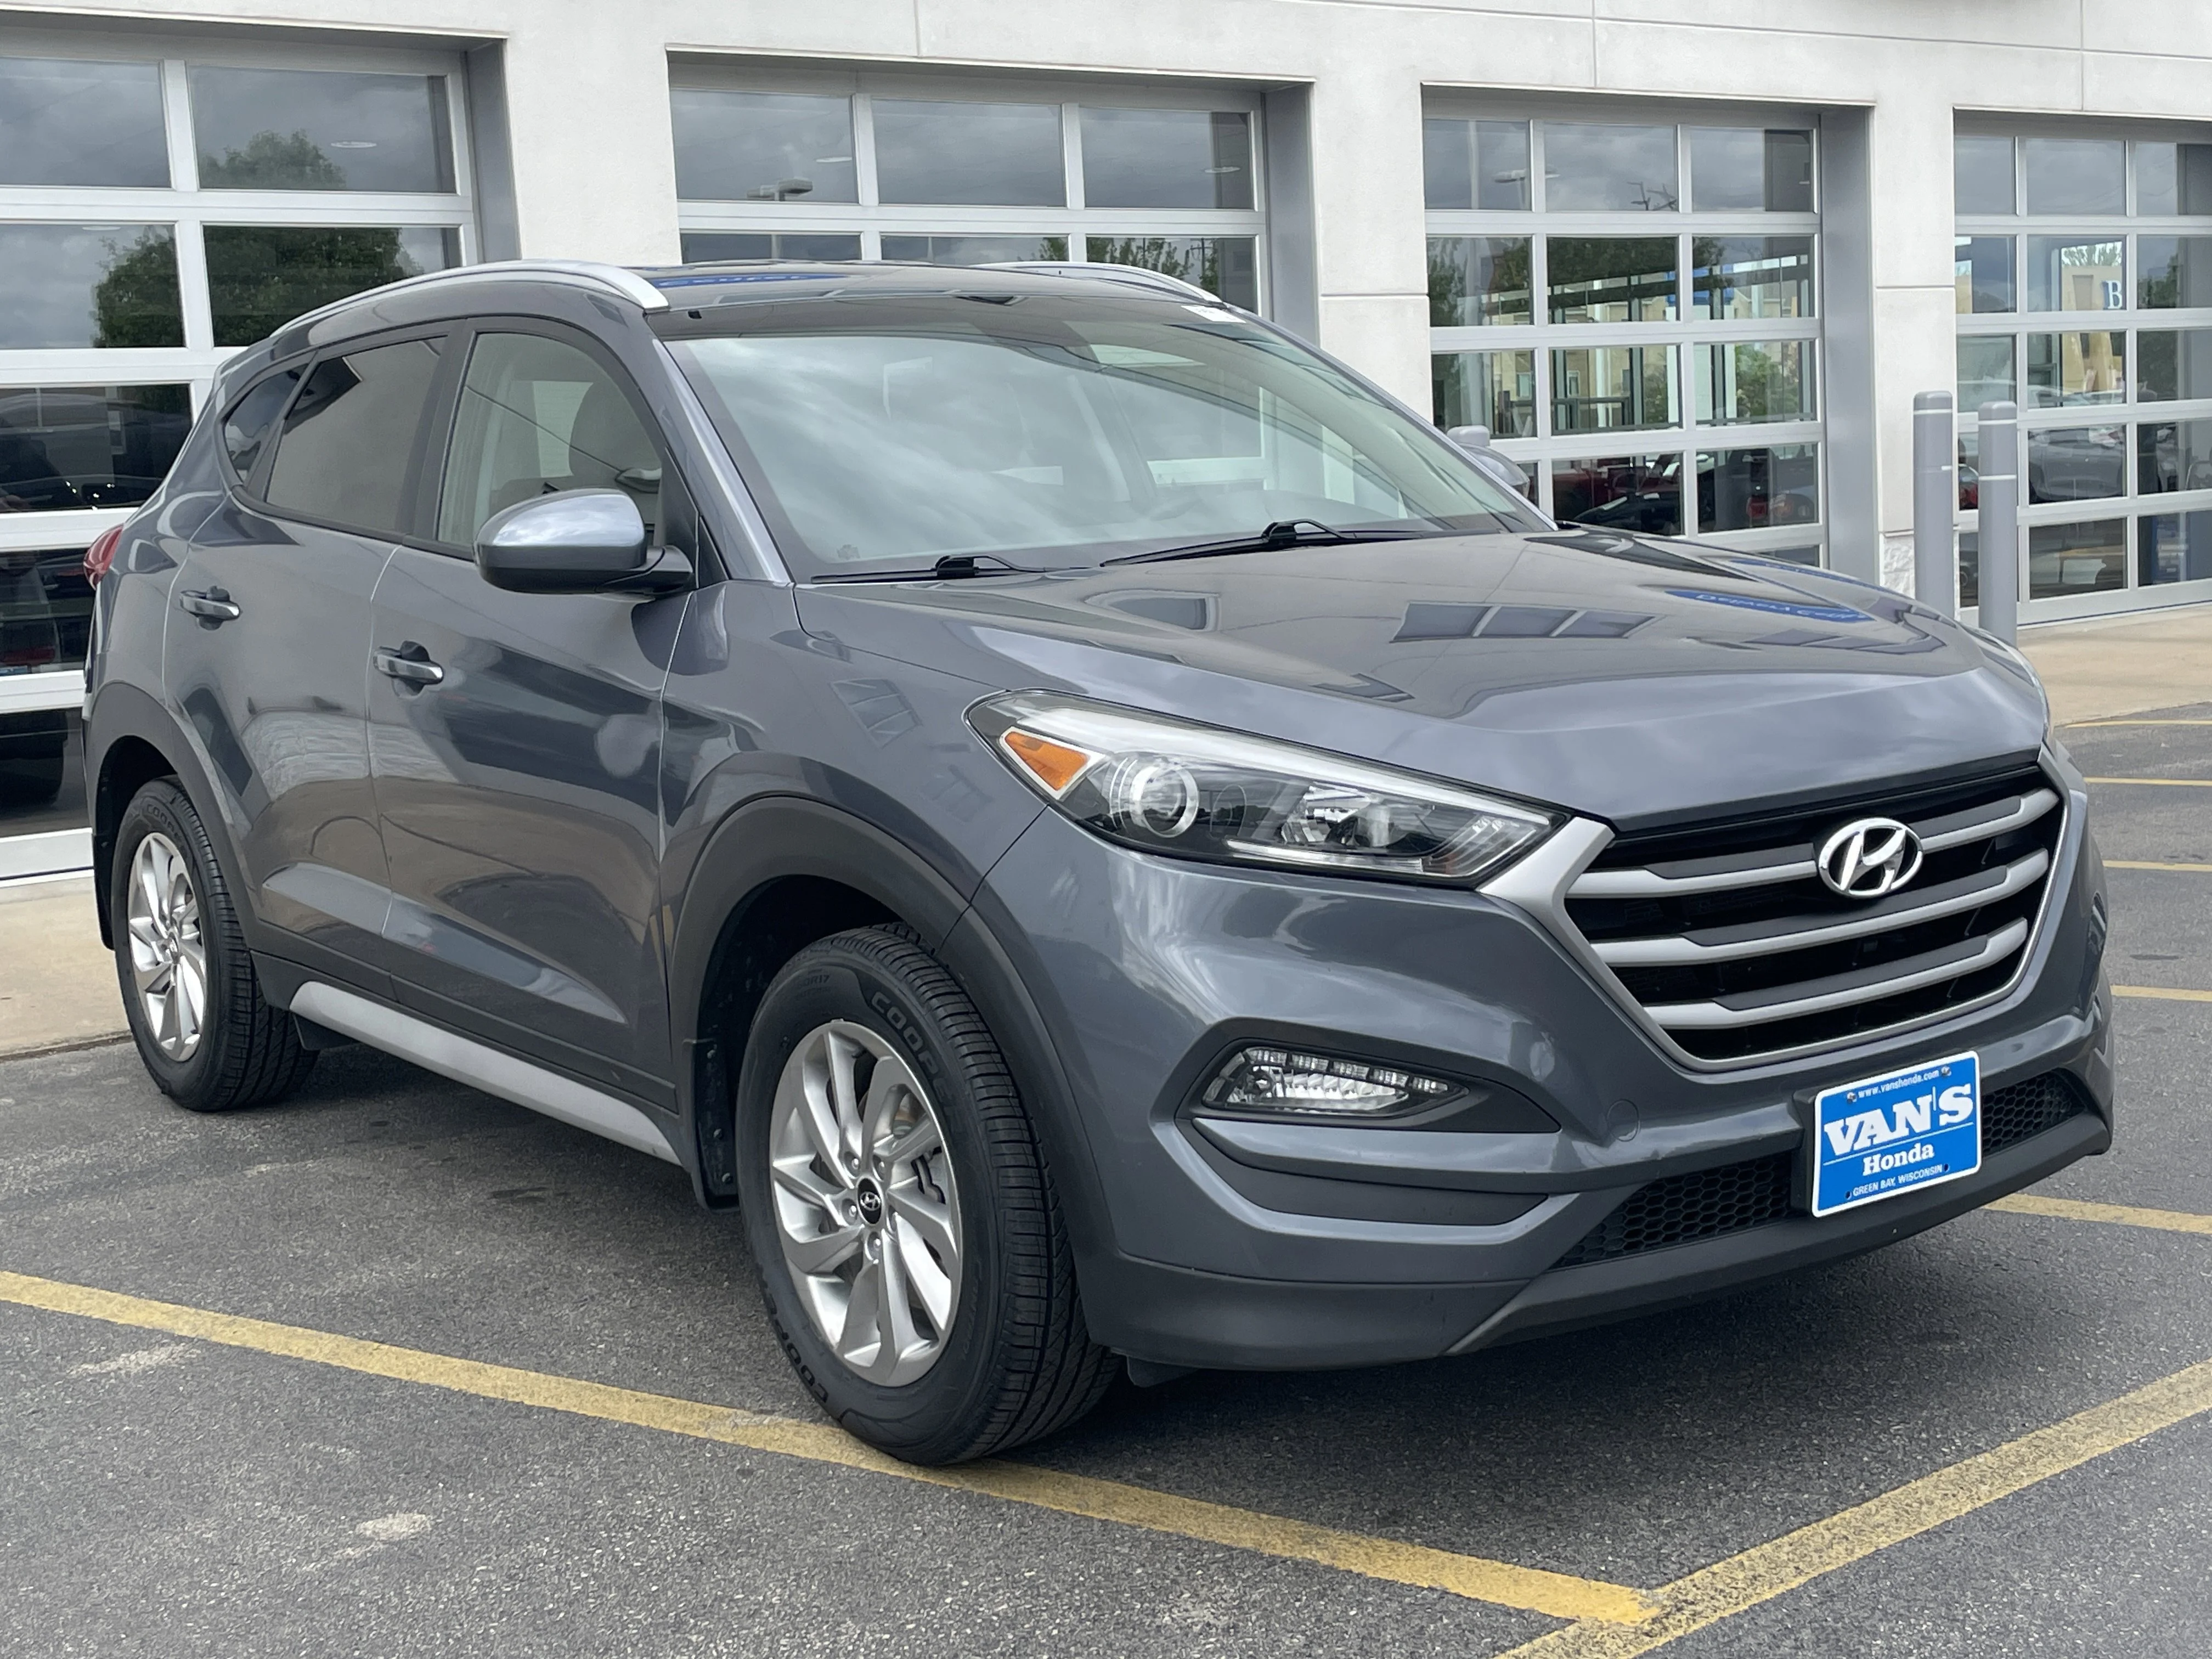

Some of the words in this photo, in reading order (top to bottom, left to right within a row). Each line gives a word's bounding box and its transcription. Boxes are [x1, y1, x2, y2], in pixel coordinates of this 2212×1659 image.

[1858, 1069, 1939, 1098] www.vanshonda.com
[1824, 1083, 1974, 1156] VAN'S
[1862, 1143, 1935, 1176] Honda
[1853, 1181, 1878, 1197] GREEN
[1898, 1164, 1943, 1184] WISCONSIN
